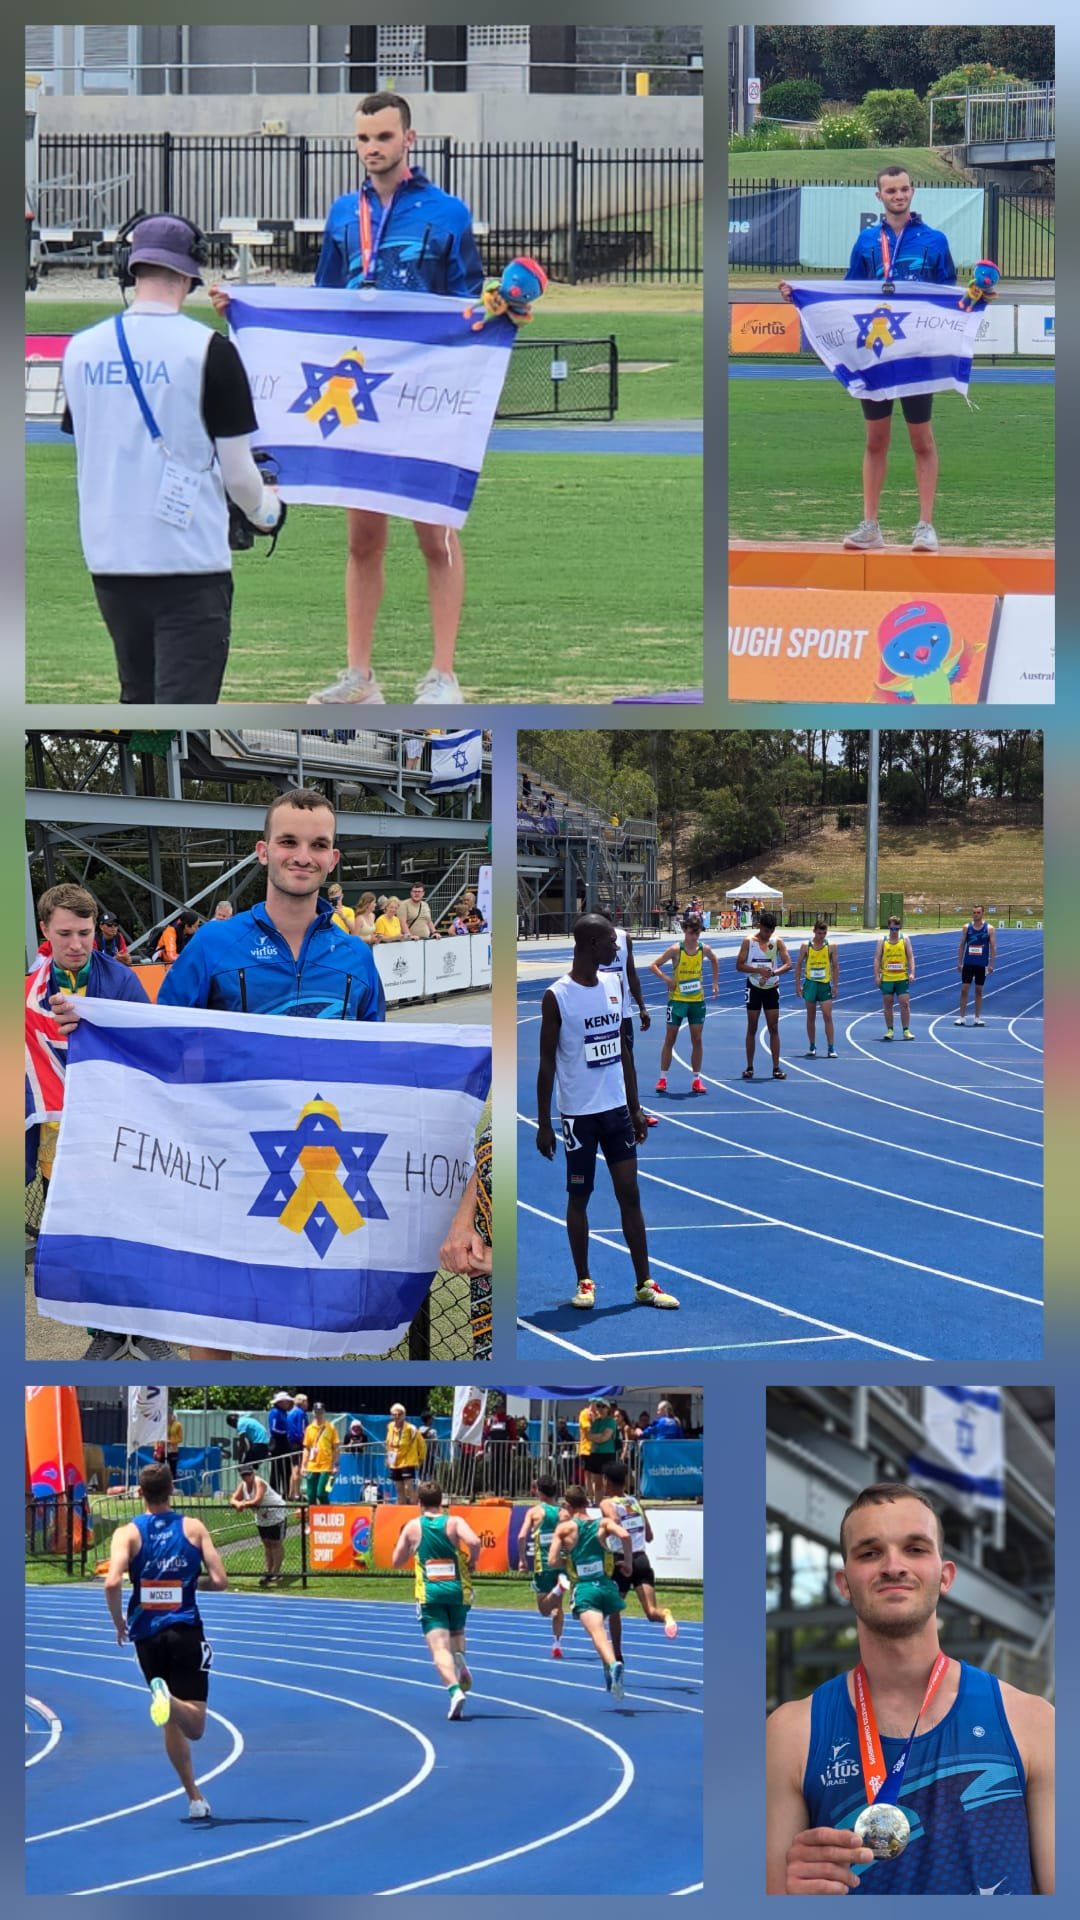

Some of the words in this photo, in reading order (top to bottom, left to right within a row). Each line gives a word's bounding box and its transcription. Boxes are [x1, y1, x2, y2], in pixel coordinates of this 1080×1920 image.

[751, 321, 786, 335] virtus
[915, 316, 968, 332] HOME
[84, 361, 170, 385] MEDIA
[397, 382, 481, 416] HOME
[786, 628, 870, 659] SPORT
[250, 946, 278, 956] virtus
[584, 1012, 620, 1029] KENYA
[592, 1041, 617, 1057] 1011
[113, 1126, 227, 1192] FINALLY
[479, 1532, 496, 1548] tus
[149, 1590, 173, 1600] MOZES
[202, 1643, 212, 1669] 2
